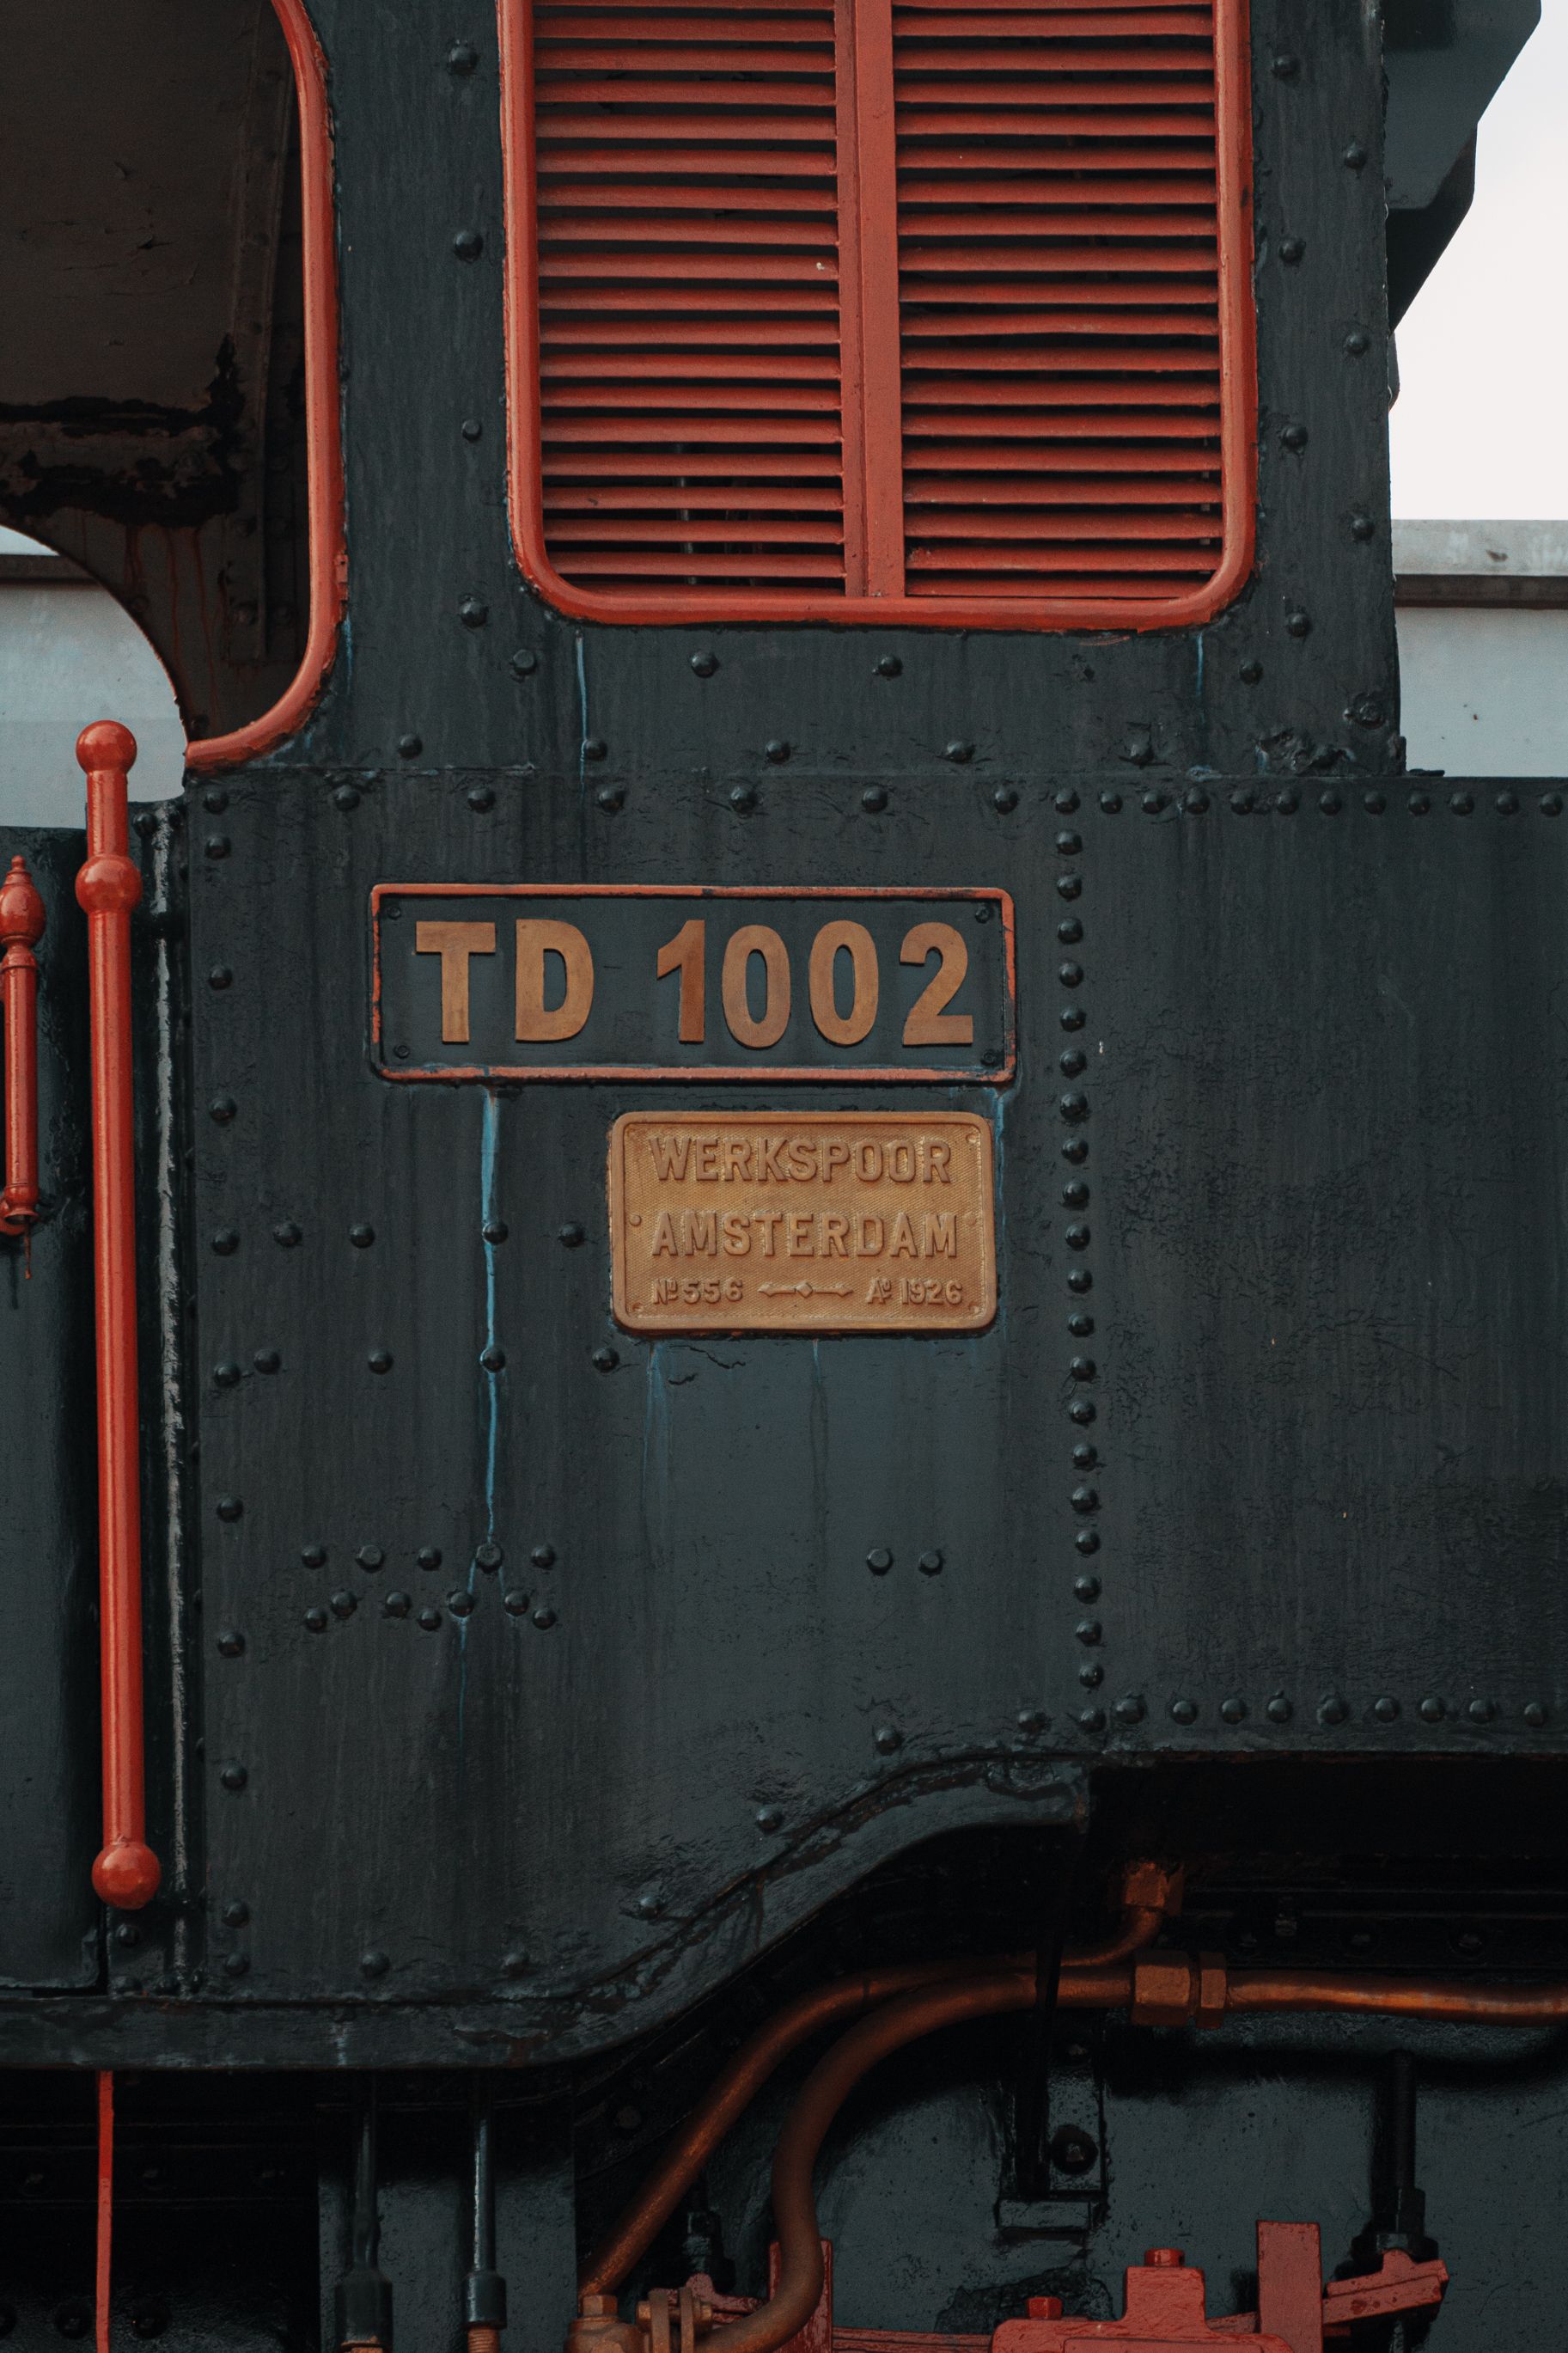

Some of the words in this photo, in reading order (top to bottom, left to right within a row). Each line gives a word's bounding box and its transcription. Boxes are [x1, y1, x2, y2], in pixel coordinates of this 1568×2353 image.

[415, 919, 594, 1042] TD
[656, 919, 973, 1048] 1002
[650, 1136, 952, 1183] WERKSPOOR
[651, 1210, 958, 1258] AMSTERDAM
[682, 1278, 743, 1304] 556
[900, 1278, 963, 1305] 1926
